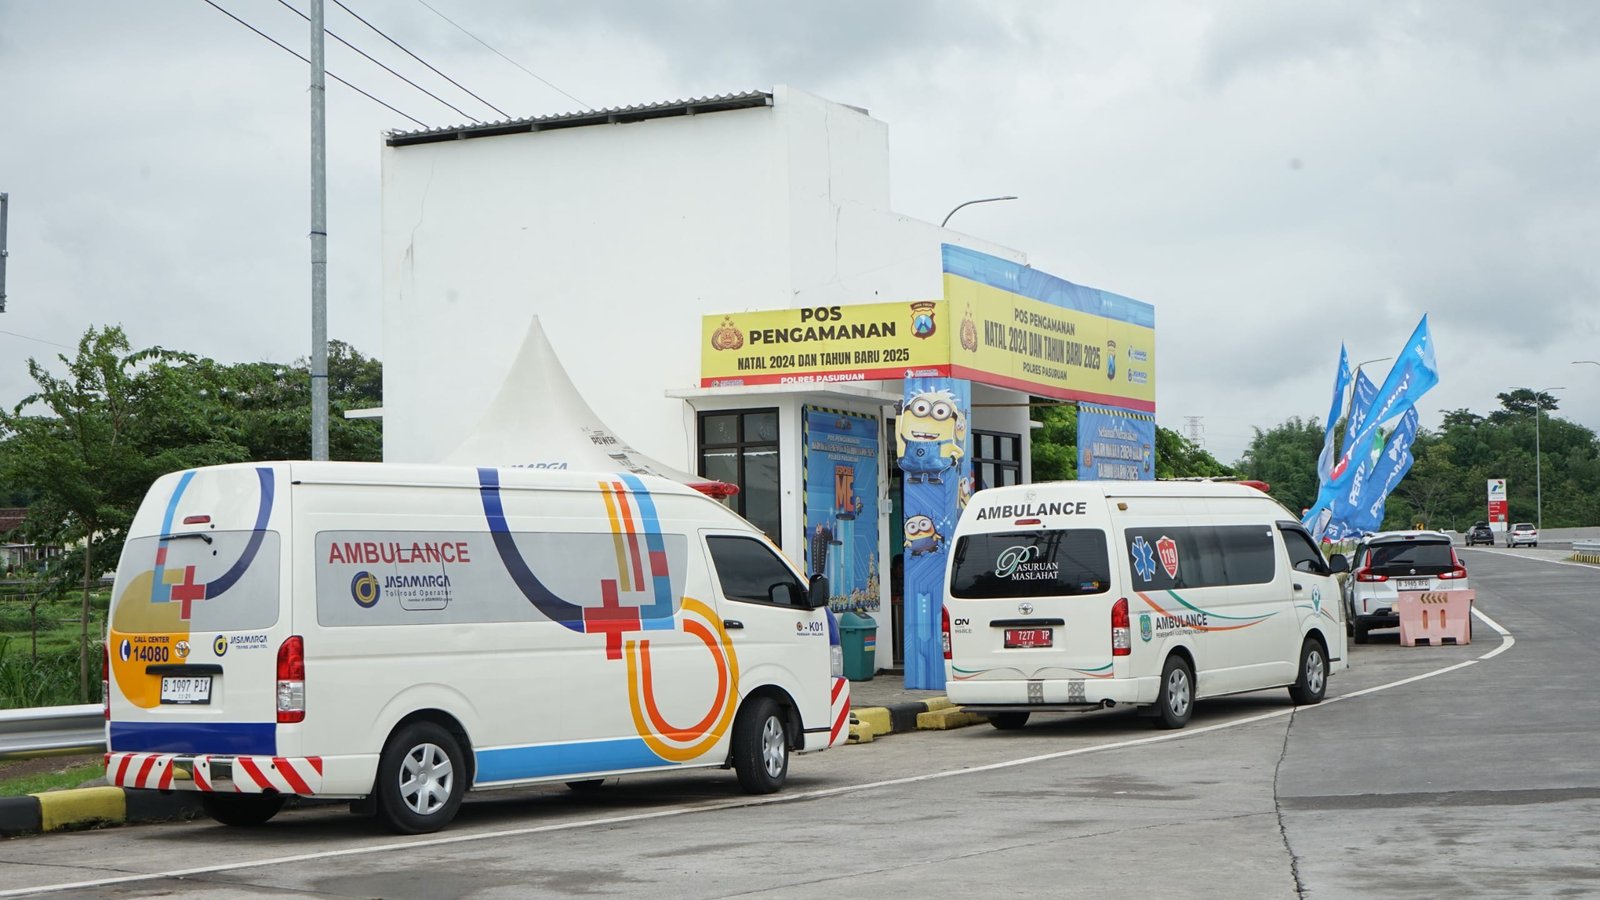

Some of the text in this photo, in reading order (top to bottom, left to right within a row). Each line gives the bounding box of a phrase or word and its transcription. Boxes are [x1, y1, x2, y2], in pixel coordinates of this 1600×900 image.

[801, 306, 842, 323] POS
[1014, 307, 1076, 336] POS PENGAMANAN
[749, 321, 896, 345] PENGAMANAN
[984, 319, 1007, 350] NATAL
[1008, 326, 1028, 355] 2024
[1029, 329, 1043, 358] DAN
[1044, 333, 1065, 363] TAHUN
[1066, 340, 1083, 367] BARU
[1083, 344, 1101, 370] 2025
[737, 348, 910, 370] NATAL 2024 DAN TAHUN BARU 2025
[780, 372, 865, 384] POLRES PASURUAN
[1022, 361, 1068, 380] POLRES PASURUAN
[590, 436, 617, 446] POWER
[976, 502, 1087, 520] AMBULANCE
[329, 542, 470, 564] AMBULANCE
[1162, 547, 1176, 565] 119
[384, 575, 451, 588] JASAMARGA
[1011, 571, 1059, 581] MASLAHAT
[809, 622, 823, 631] K01
[954, 618, 969, 626] ON
[1156, 614, 1208, 630] AMBULANCE
[230, 635, 268, 645] JASAMARGA
[1006, 630, 1050, 640] N 7277 TP
[133, 646, 169, 662] 14080
[163, 679, 208, 693] B 1997 PIX
